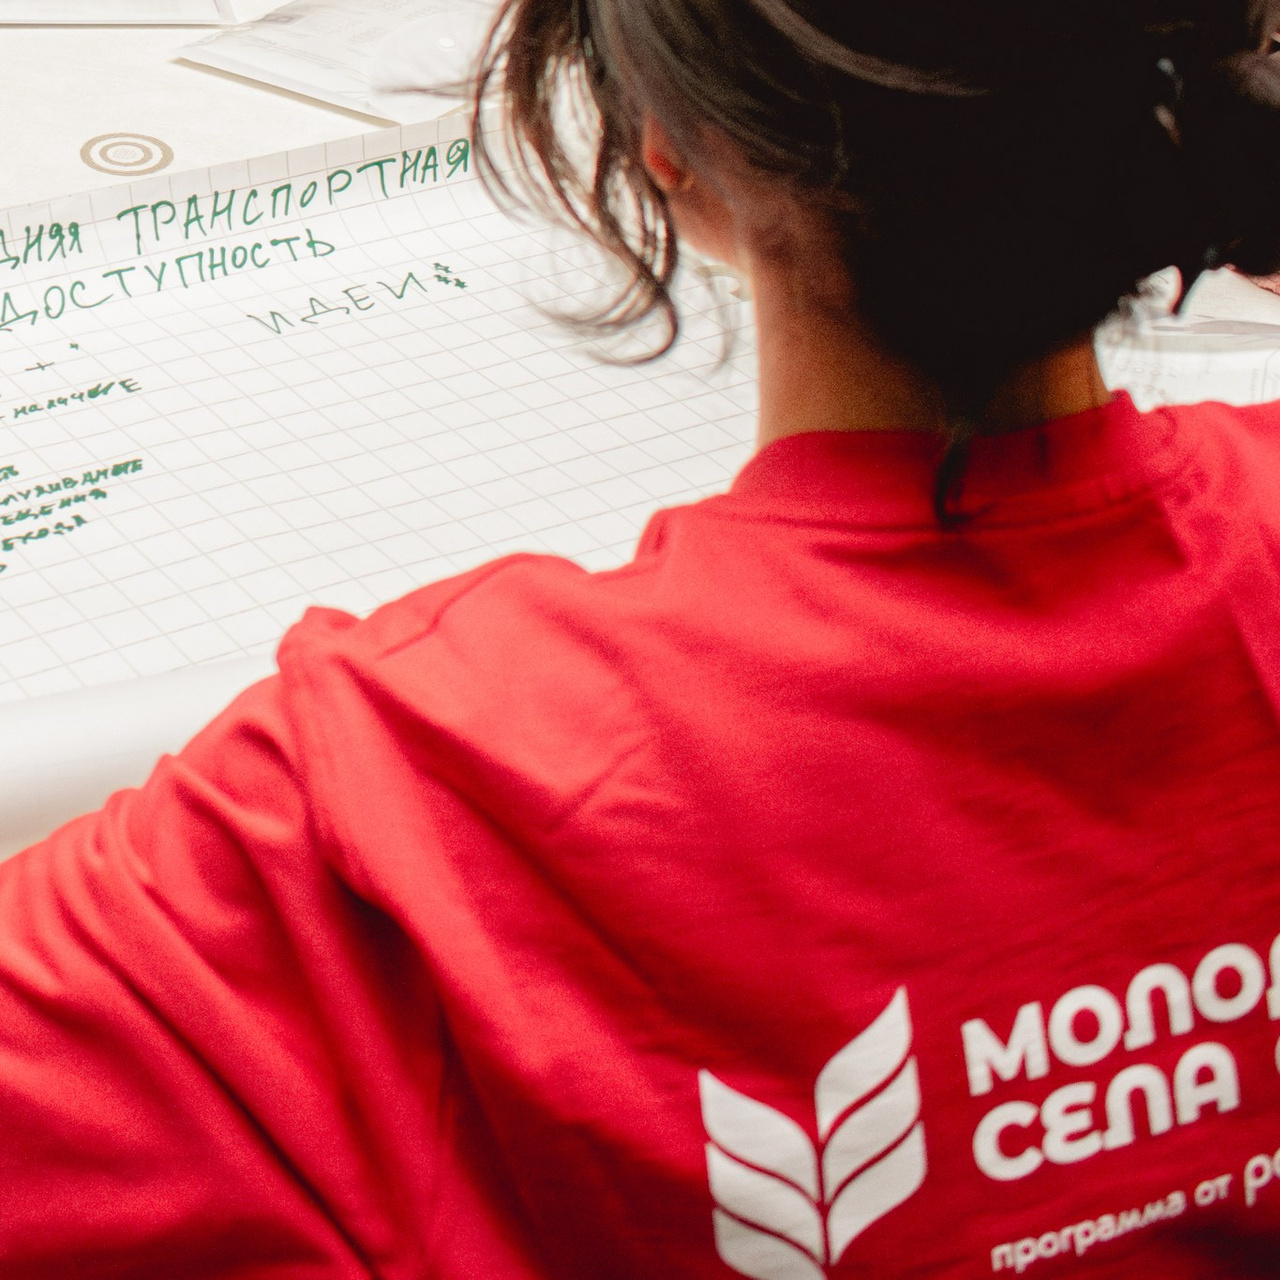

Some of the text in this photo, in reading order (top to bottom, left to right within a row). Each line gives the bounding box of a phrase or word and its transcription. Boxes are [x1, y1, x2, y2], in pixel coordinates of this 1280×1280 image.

[117, 138, 470, 254] ТРАНСПОРТНАЯ
[972, 1041, 1240, 1182] СЕЛА
[991, 1144, 1280, 1274] программа от р
